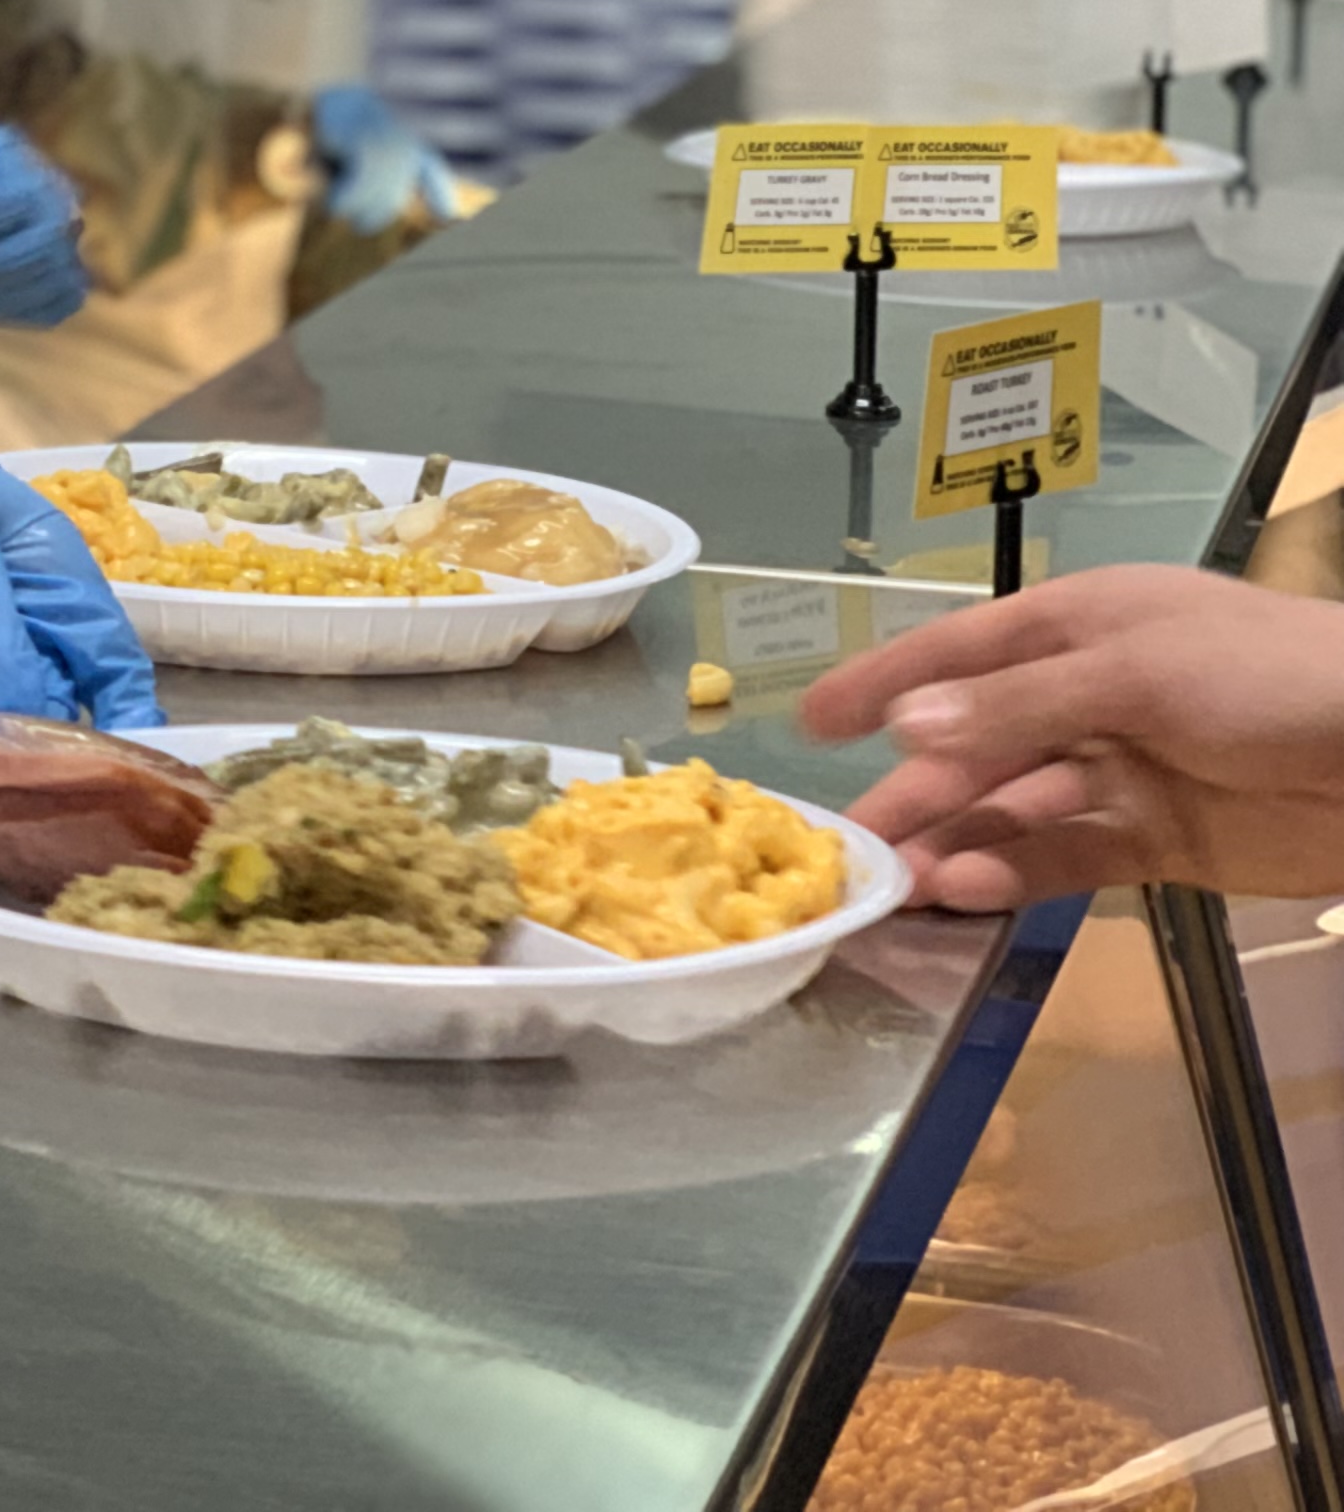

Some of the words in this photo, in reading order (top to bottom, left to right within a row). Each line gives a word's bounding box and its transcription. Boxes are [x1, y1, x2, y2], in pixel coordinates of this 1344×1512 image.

[748, 142, 770, 153] EAT
[774, 141, 863, 153] OCCASIONALLY
[893, 143, 914, 152] EAT
[918, 143, 1008, 152] OCCASIONALLY
[768, 176, 798, 184] TURKEY
[799, 175, 827, 183] GRAVY
[898, 172, 920, 182] Corn
[922, 172, 949, 182] Bread
[951, 172, 990, 183] Dressing
[956, 348, 977, 364] EAT
[979, 330, 1058, 357] OCCASIONALLY
[971, 379, 998, 396] ROAST
[1001, 372, 1032, 388] TURKEY
